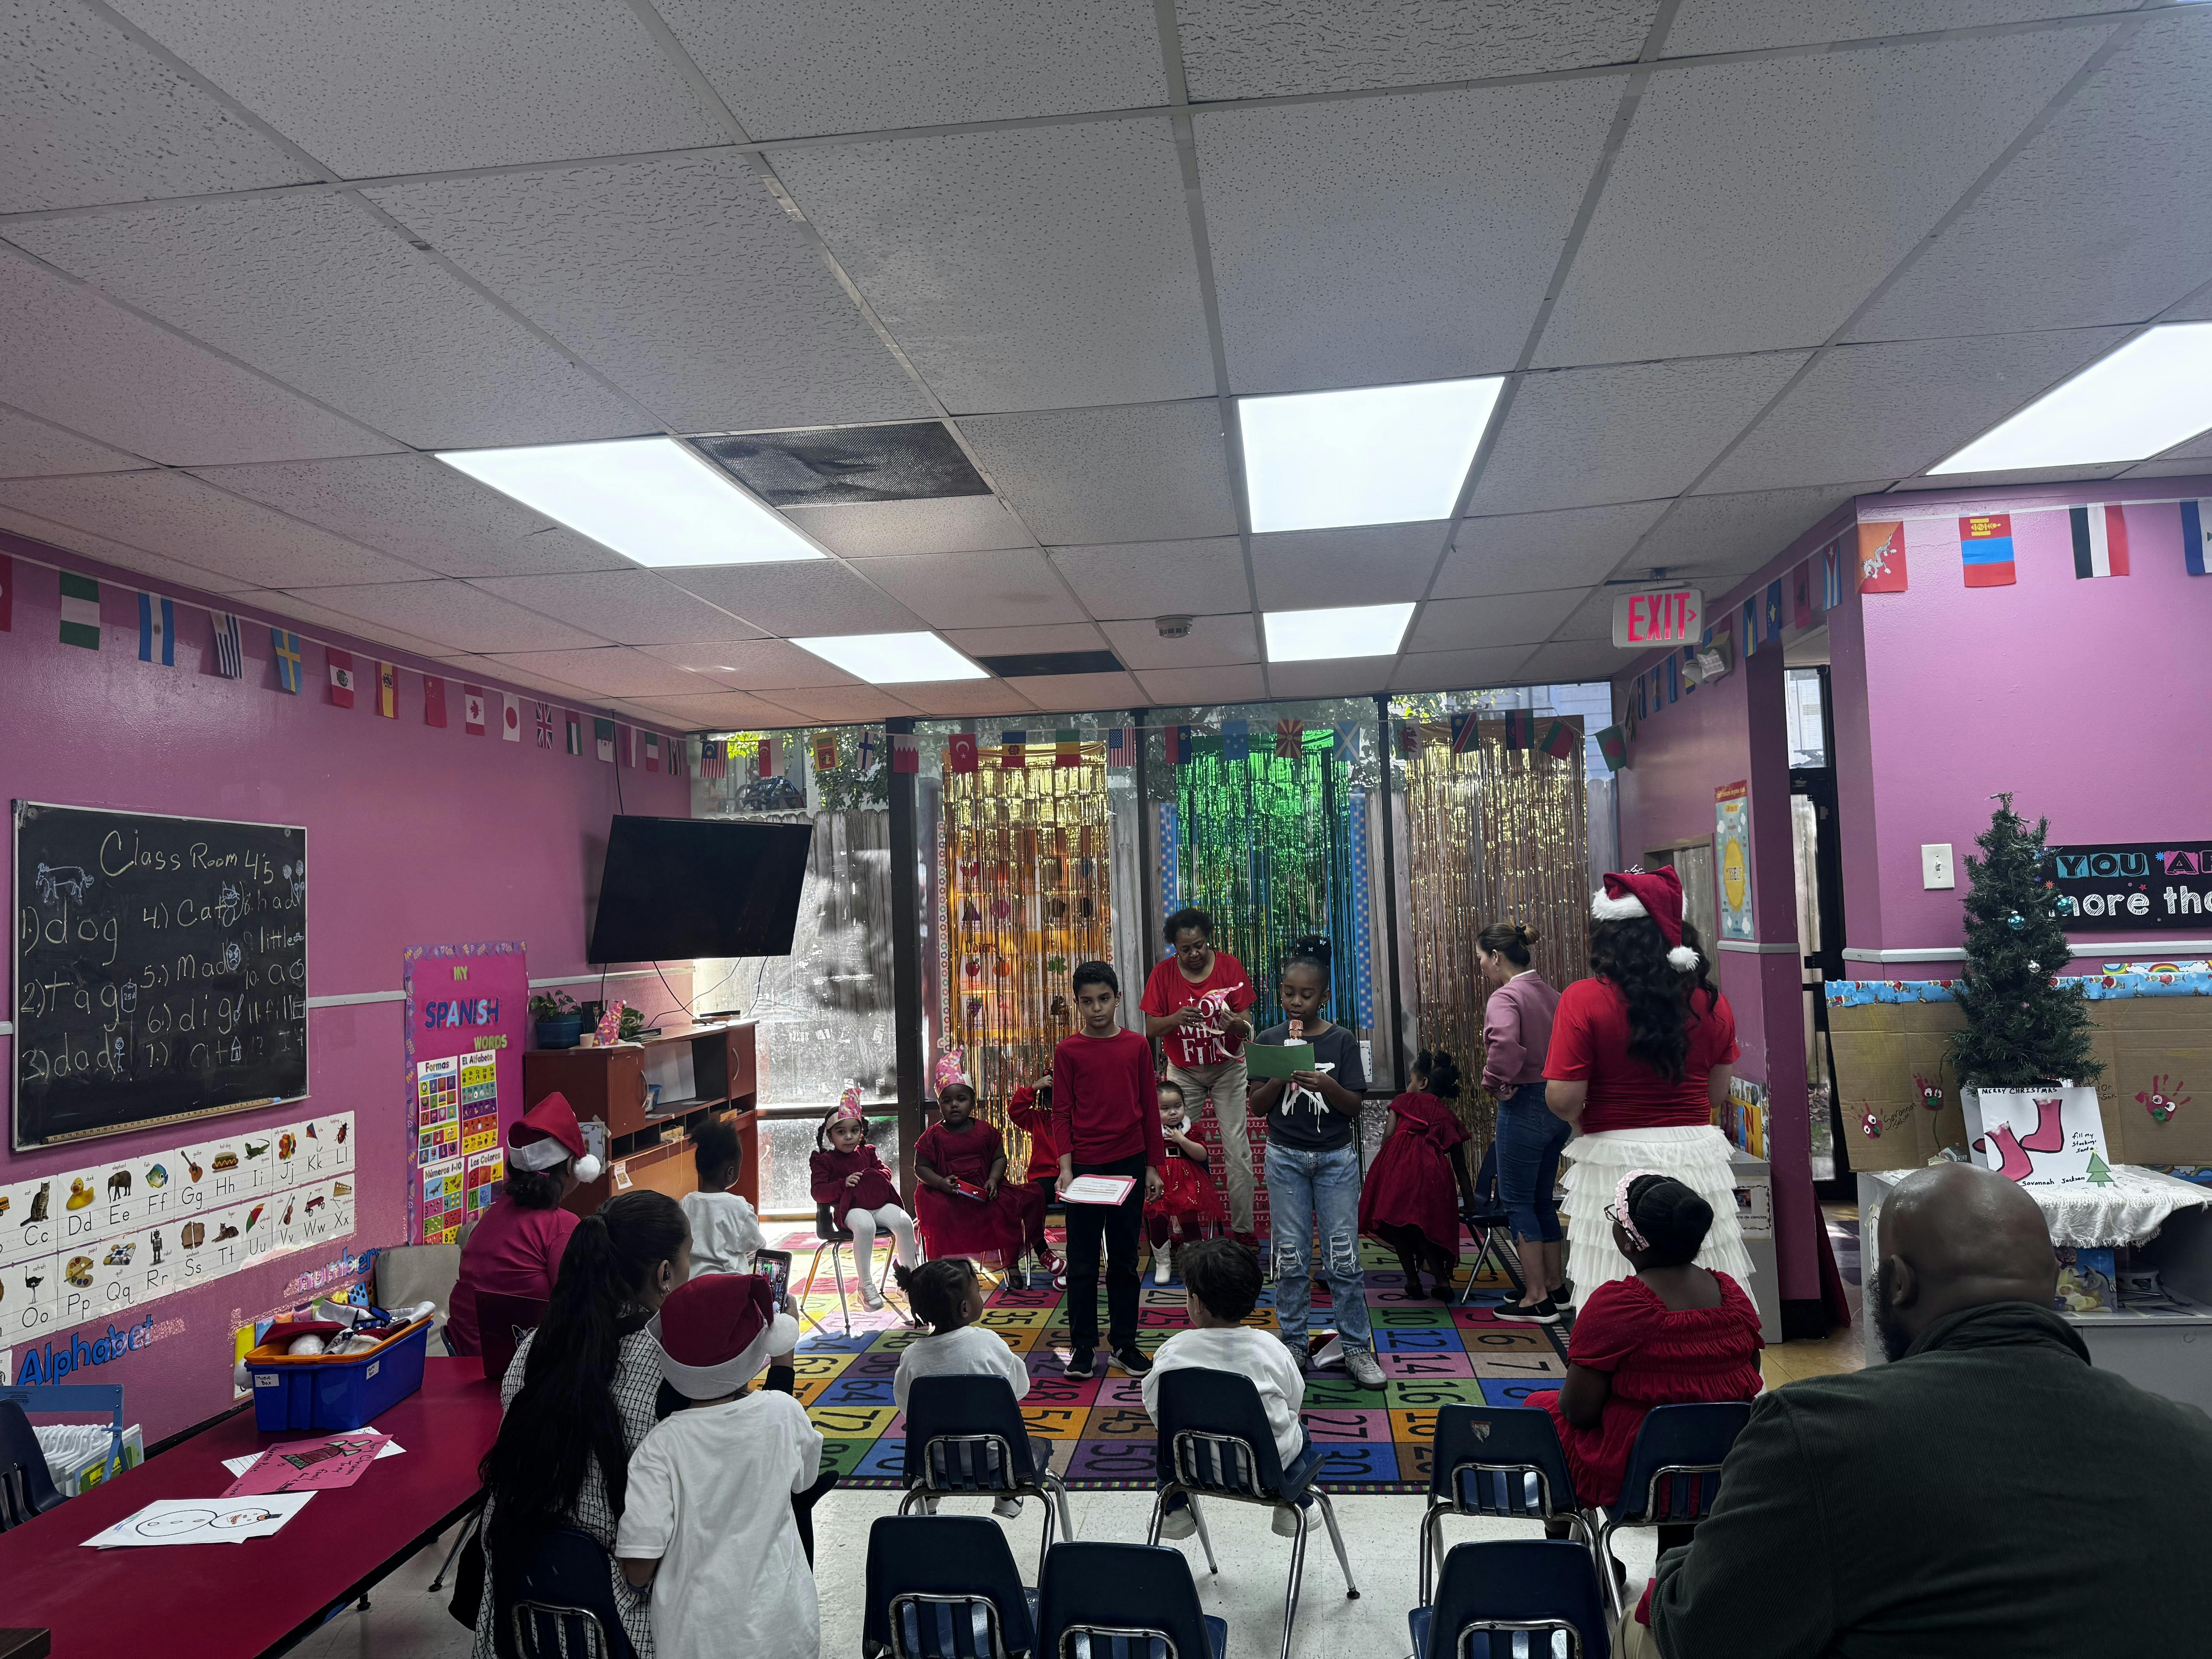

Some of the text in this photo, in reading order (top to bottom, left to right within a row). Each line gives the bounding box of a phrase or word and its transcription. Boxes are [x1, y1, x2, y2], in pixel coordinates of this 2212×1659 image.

[1628, 592, 1691, 642] EXIT
[190, 842, 237, 869] Room
[2057, 853, 2149, 878] YOU
[45, 895, 117, 967] dog
[261, 924, 295, 953] little
[453, 965, 468, 981] MY
[45, 970, 119, 1032] tag
[179, 994, 232, 1035] dig
[424, 998, 500, 1029] SPANISH
[474, 1034, 508, 1051] WORDS
[1181, 1036, 1226, 1065] FUN
[54, 1032, 116, 1077] dad
[462, 1053, 493, 1065] El Alfabeto
[425, 1061, 450, 1072] Formas
[112, 1162, 127, 1171] elephant
[308, 1154, 322, 1172] Kk
[424, 1161, 462, 1180] Números 1-10
[470, 1152, 501, 1168] Los Colores
[253, 1170, 263, 1187] Ii
[280, 1161, 294, 1185] Jj
[2021, 1176, 2085, 1187] Savannah Jackson
[216, 1176, 234, 1197] Hh
[445, 1182, 448, 1191] 2
[148, 1192, 168, 1215] Ff
[182, 1186, 203, 1210] Gg
[424, 1199, 448, 1215] 3 4
[69, 1211, 92, 1236] Dd
[110, 1204, 130, 1225] Ee
[334, 1211, 349, 1228] Xx
[424, 1217, 448, 1232] 5 6
[24, 1225, 48, 1246] Cc
[280, 1228, 294, 1245] Vv
[304, 1219, 326, 1238] Ww
[445, 1233, 448, 1243] 8
[218, 1245, 234, 1266] Tt
[249, 1237, 266, 1255] Uu
[184, 1258, 201, 1276] Ss
[147, 1269, 168, 1290] Rr
[107, 1282, 134, 1304] Qq
[995, 1290, 1050, 1307] 28
[68, 1293, 90, 1320] Pp
[1381, 1309, 1439, 1325] 10
[22, 1307, 48, 1328] Oo
[980, 1310, 1039, 1326] 35
[1386, 1330, 1448, 1348] 12
[1477, 1334, 1537, 1345] 6
[16, 1314, 154, 1386] Alphabet
[1392, 1355, 1456, 1374] 14
[1487, 1361, 1551, 1372] 7
[829, 1380, 895, 1402] 64
[1020, 1379, 1082, 1401] 48
[1302, 1382, 1363, 1405] 24
[1396, 1381, 1466, 1404] 16
[811, 1410, 882, 1432] 72
[1098, 1410, 1158, 1434] 45
[1300, 1414, 1369, 1438] 27
[1084, 1444, 1157, 1472] 50
[1318, 1448, 1373, 1475] 30
